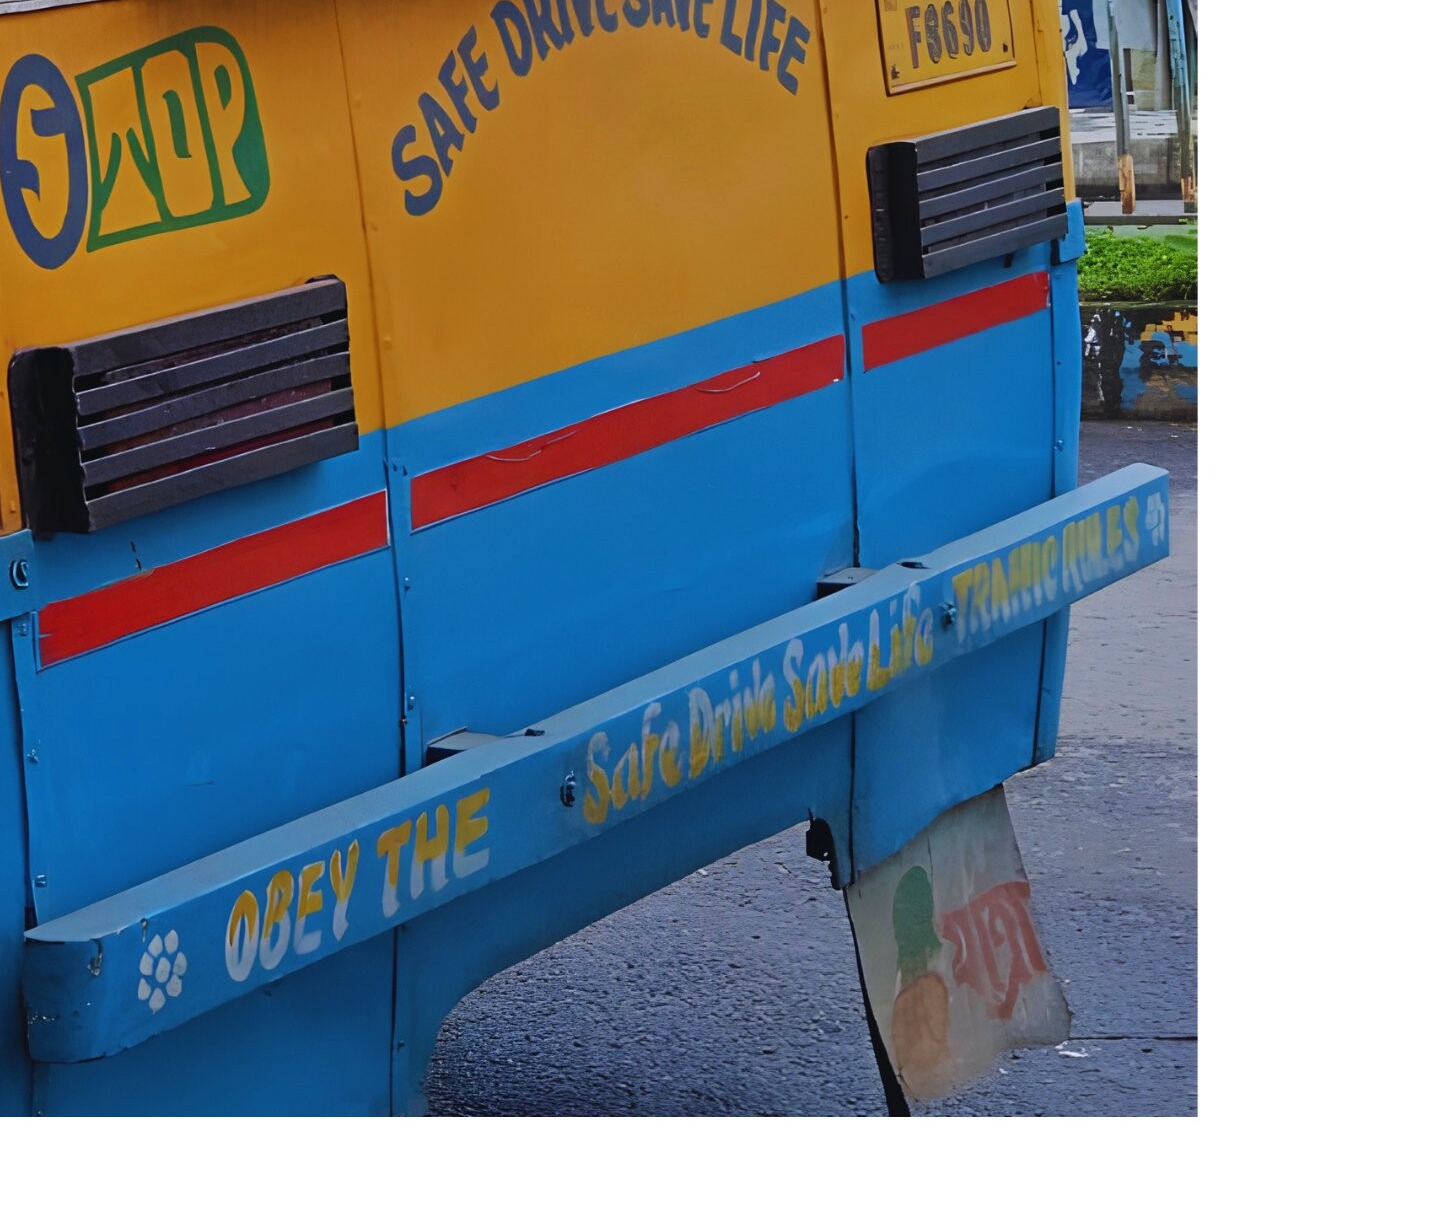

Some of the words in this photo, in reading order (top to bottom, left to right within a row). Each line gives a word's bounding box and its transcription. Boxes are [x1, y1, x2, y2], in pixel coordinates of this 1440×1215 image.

[391, 24, 501, 217] SAFE
[1062, 495, 1140, 595] RULES
[583, 700, 683, 825] Safe
[782, 637, 865, 734] Save
[866, 580, 935, 692] Life
[224, 838, 361, 983] OBEY
[376, 786, 492, 920] THE
